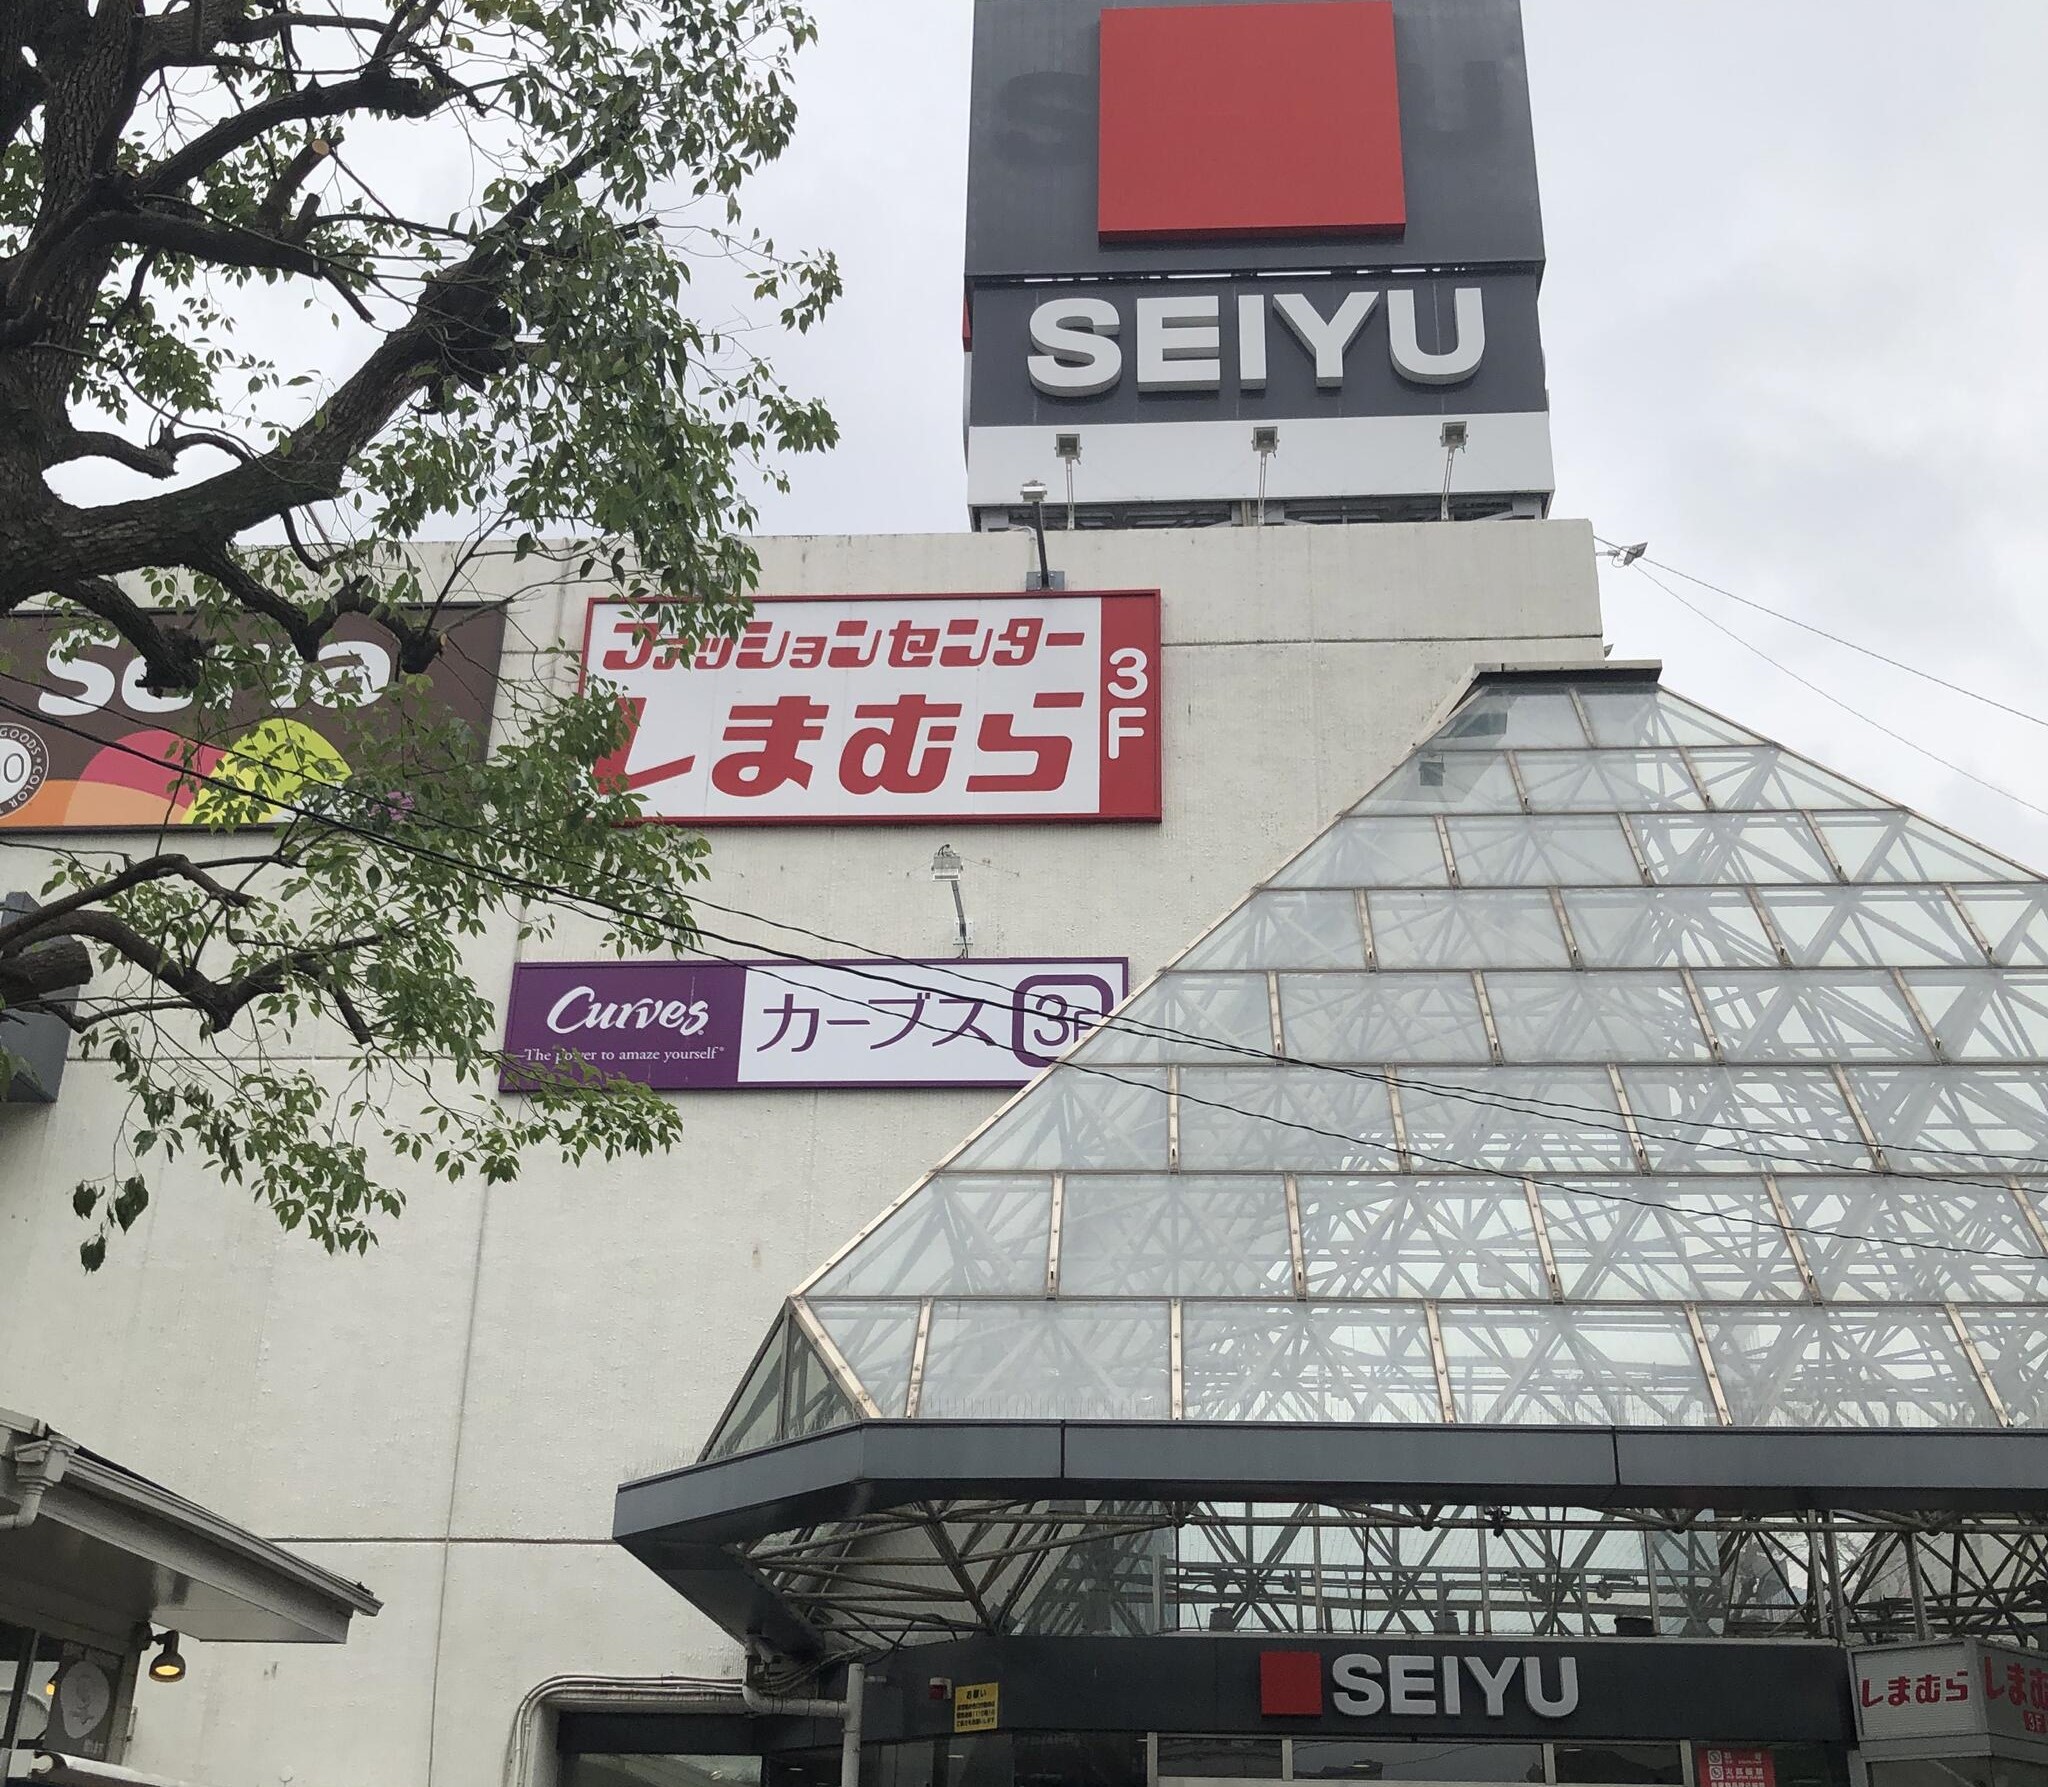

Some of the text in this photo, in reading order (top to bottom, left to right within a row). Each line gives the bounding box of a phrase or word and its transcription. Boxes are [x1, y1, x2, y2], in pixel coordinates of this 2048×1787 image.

[1027, 288, 1486, 398] SEIYU
[602, 617, 1085, 670] ファッションセンター
[592, 692, 1085, 797] しまむら
[9, 766, 43, 808] COLOR
[547, 986, 709, 1036] Curves
[756, 992, 996, 1052] カーブス
[1034, 994, 1100, 1046] 3F
[601, 1051, 616, 1061] to
[619, 1051, 660, 1061] amaze
[1332, 1653, 1579, 1718] SEIYU
[1861, 1670, 1969, 1708] しまむら
